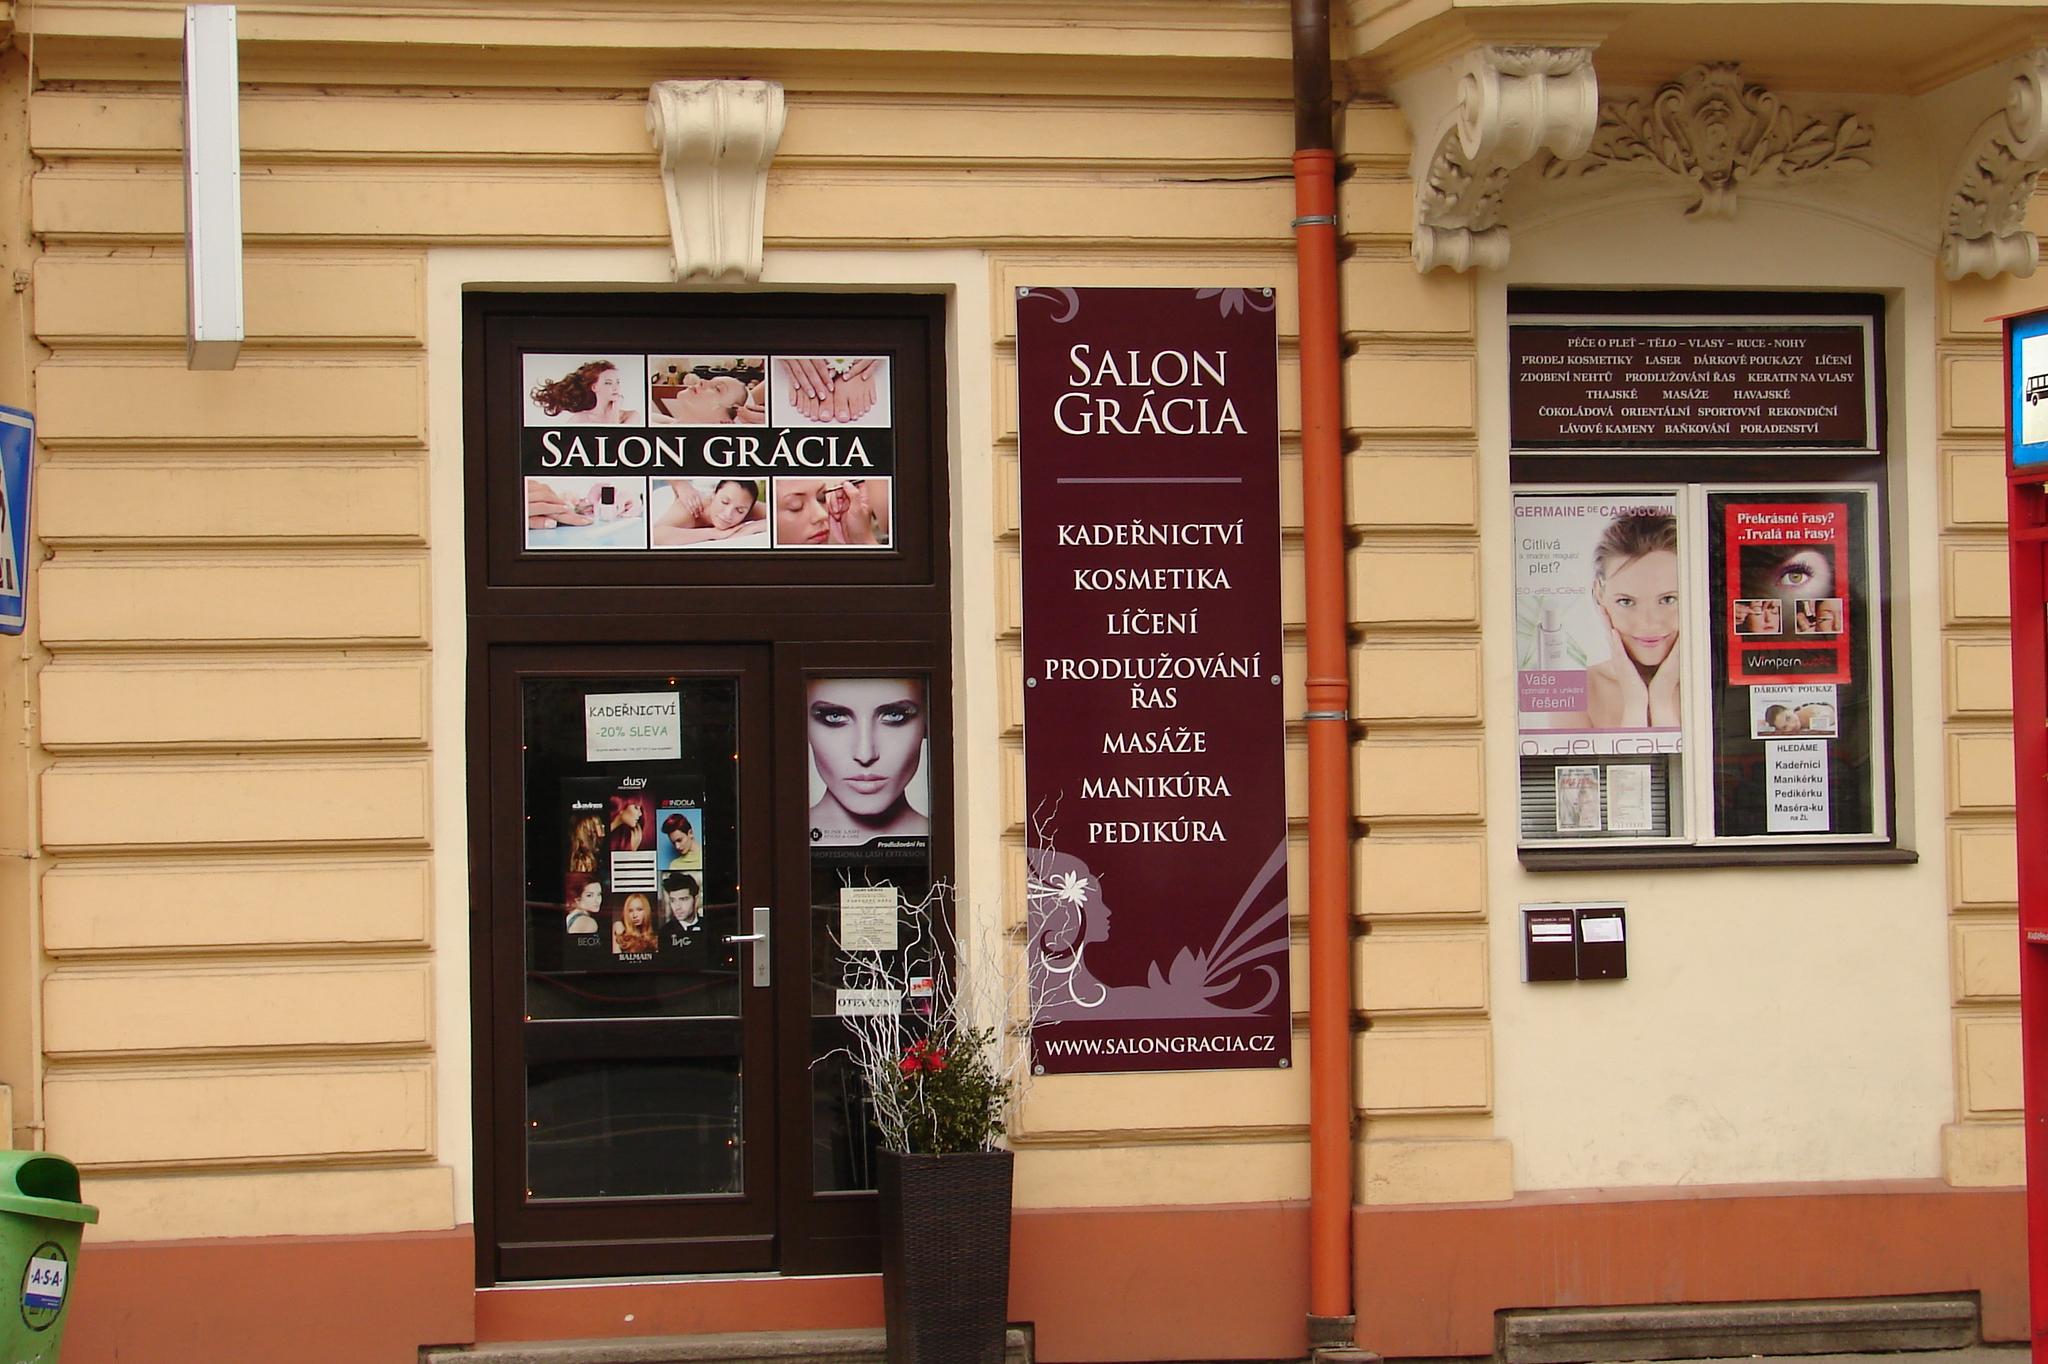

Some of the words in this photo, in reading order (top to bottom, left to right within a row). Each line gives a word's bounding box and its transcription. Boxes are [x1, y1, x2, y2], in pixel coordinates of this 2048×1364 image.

[1598, 338, 1606, 348] O
[1688, 338, 1725, 348] VLASY
[1737, 338, 1766, 348] RUCE
[1774, 338, 1806, 348] NOHY
[1068, 344, 1227, 387] SALON
[1521, 355, 1564, 365] PRODEJ
[1567, 355, 1633, 365] KOSMETIKY
[1645, 355, 1681, 365] LASER
[1694, 354, 1747, 365] DÁRKOVÉ
[1750, 356, 1803, 365] POUKAZY
[1815, 354, 1852, 365] LÍČENÍ
[1520, 372, 1570, 382] ZDOBENÍ
[1573, 371, 1613, 382] NEHTŮ
[1625, 371, 1710, 382] PRODLUŽOVÁNÍ
[1713, 371, 1736, 382] ŘAS
[1748, 373, 1798, 382] KERATIN
[1800, 373, 1816, 382] NA
[1818, 373, 1854, 382] VLASY
[1586, 389, 1638, 399] THAJSKÉ
[1662, 389, 1709, 399] MASÁŽE
[1734, 388, 1791, 399] HAVAJSKÉ
[1053, 389, 1247, 435] GRÁCIA
[1538, 406, 1614, 417] ČOKOLÁDOVÁ
[1621, 406, 1691, 417] ORIENTÁLNÍ
[1697, 406, 1761, 417] SPORTOVNÍ
[1768, 405, 1838, 417] REKONDIČNÍ
[1559, 423, 1602, 434] LÁVOVÉ
[1604, 425, 1655, 434] KAMENY
[1664, 423, 1730, 434] BAŇKOVÁNÍ
[1740, 423, 1819, 434] PORADENSTVÍ
[541, 430, 687, 468] SALON
[702, 428, 874, 468] GRÁCIA
[1514, 506, 1585, 517] GERMAINE
[1587, 505, 1599, 513] DE
[1737, 512, 1799, 524] Překrásné
[1802, 512, 1834, 525] řasy?
[1057, 519, 1244, 546] KADEŘNICTVÍ
[1785, 530, 1801, 539] na
[1804, 528, 1835, 541] řasy!
[1522, 538, 1561, 550] Citlivá
[1073, 567, 1232, 590] KOSMETIKA
[1106, 608, 1198, 635] LÍČENÍ
[1044, 652, 1262, 680] PRODLUŽOVÁNÍ
[1525, 673, 1556, 685] Vaše
[1130, 683, 1178, 709] ŘAS
[1531, 696, 1575, 708] řešení!
[589, 701, 676, 717] KADEŘNICTVÍ
[596, 726, 626, 738] -20%
[629, 725, 668, 737] SLEVA
[1102, 727, 1207, 754] MASÁŽE
[1777, 744, 1819, 752] HLEDÁME
[622, 776, 647, 788] dusy
[1080, 771, 1231, 799] MANIKÚRA
[1773, 775, 1823, 783] Manikérku
[1774, 789, 1823, 798] Pedikérku
[1088, 816, 1227, 844] PEDIKÚRA
[619, 953, 653, 961] BALMAIN
[1045, 1034, 1276, 1057] WWW.SALONGRACIA.CZ
